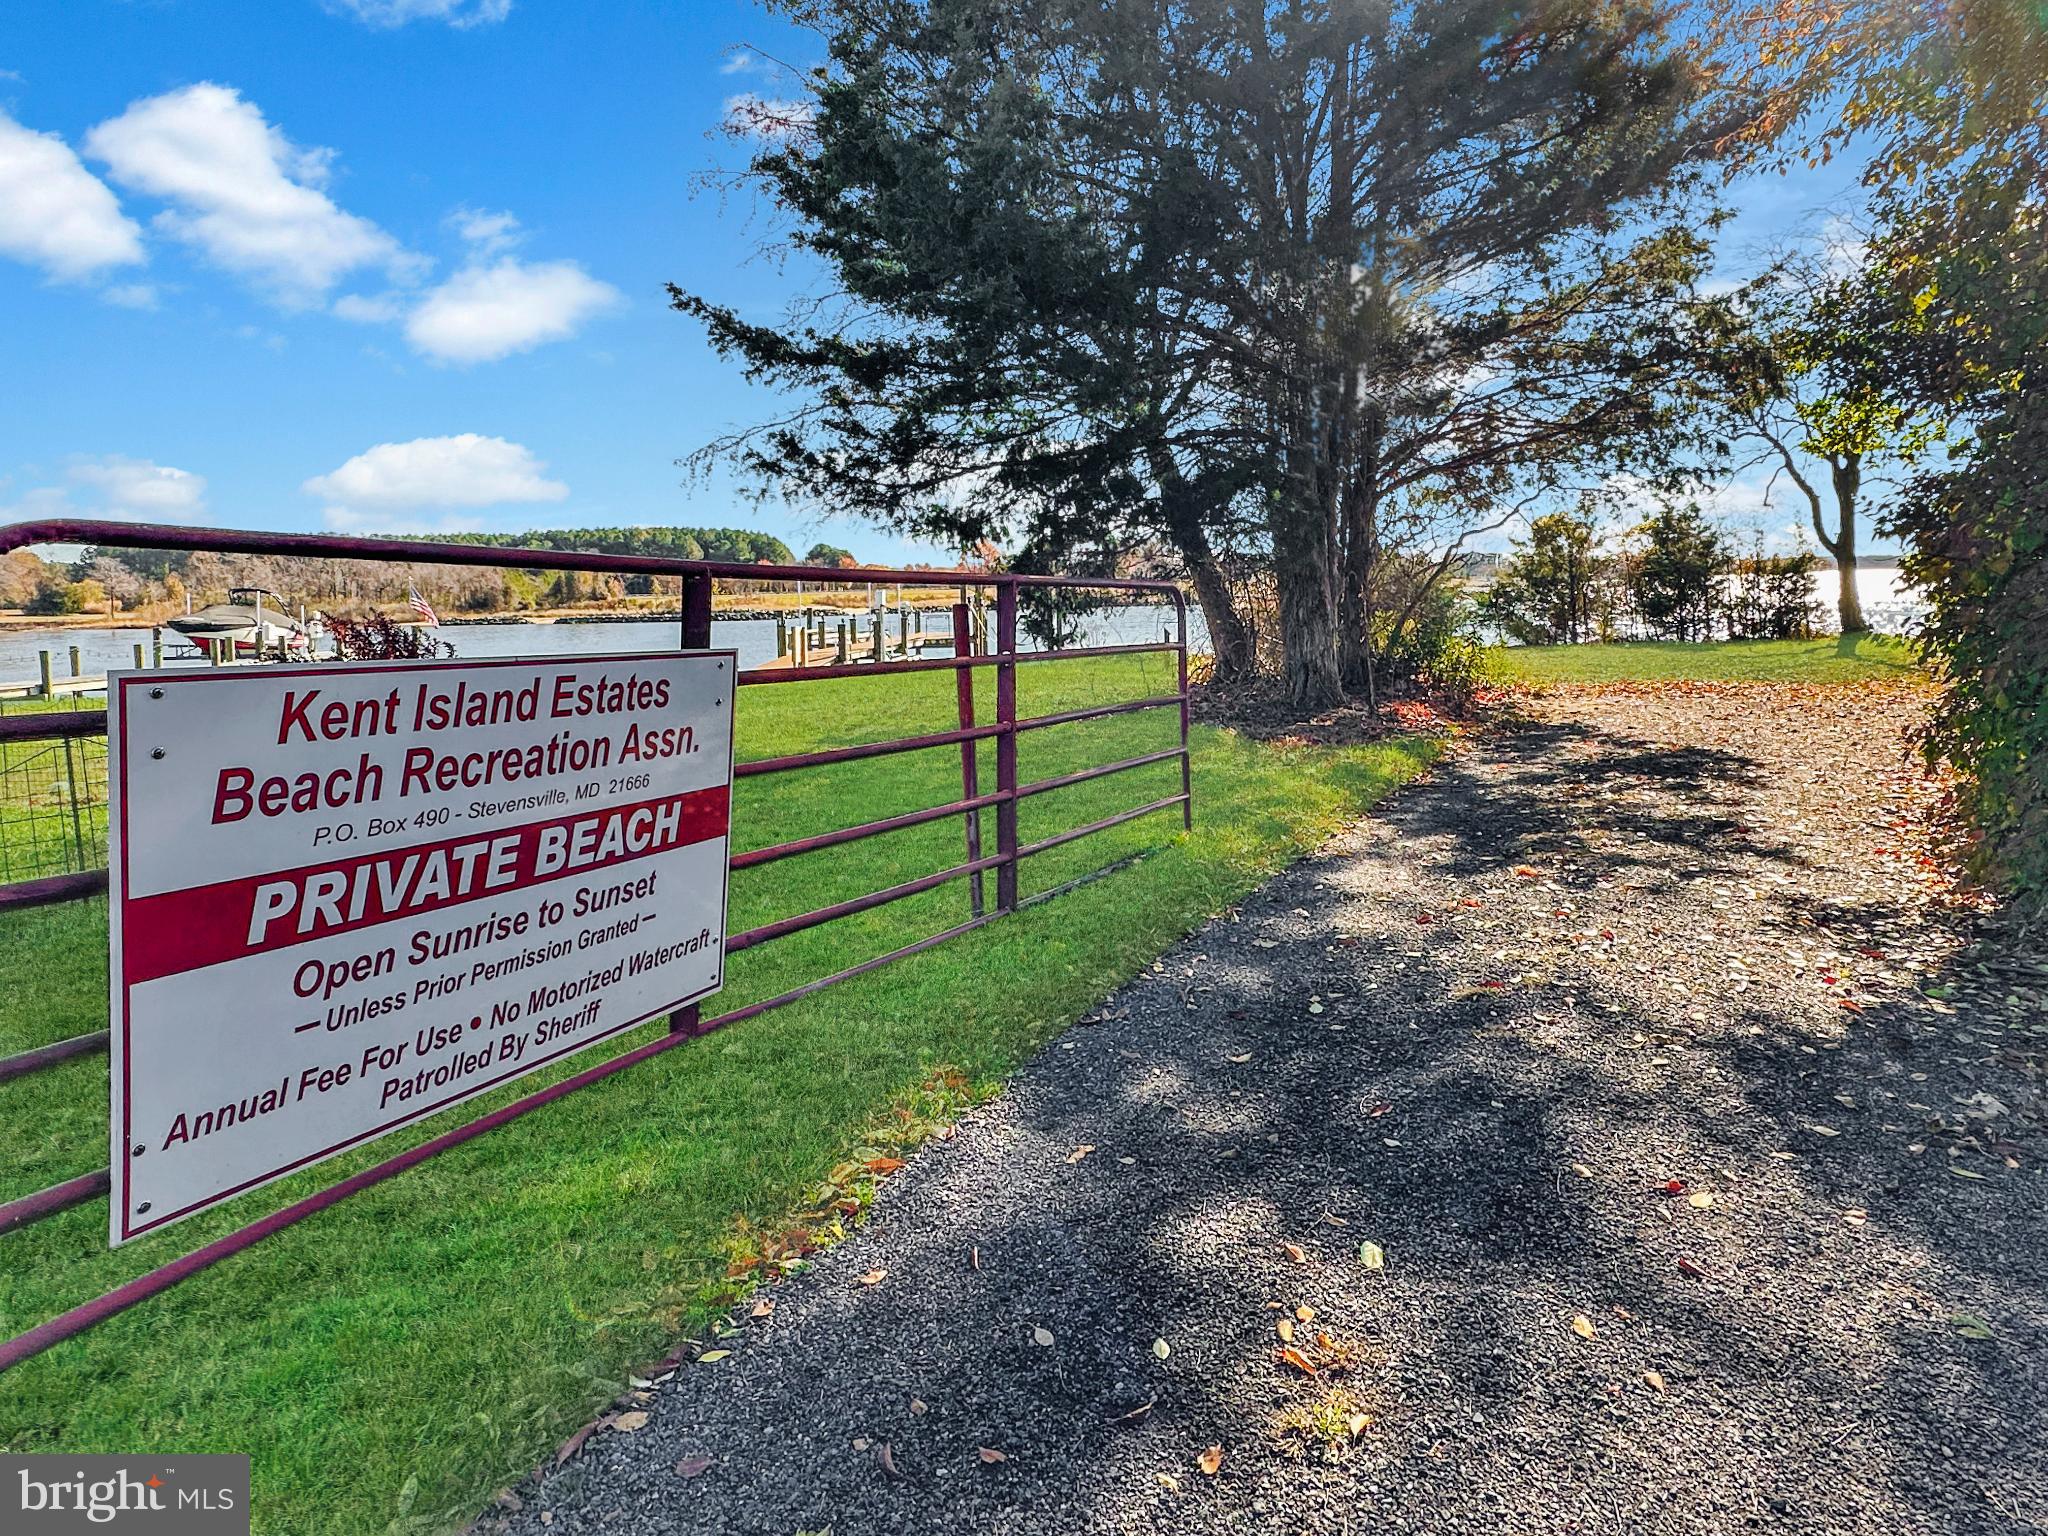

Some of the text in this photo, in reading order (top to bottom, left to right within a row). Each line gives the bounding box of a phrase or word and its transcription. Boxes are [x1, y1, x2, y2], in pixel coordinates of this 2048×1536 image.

[278, 673, 670, 744] Kent Island Estates
[211, 723, 700, 824] Beach Recreation Assn.
[313, 824, 358, 846] P.O.
[367, 817, 407, 839] Box
[414, 808, 449, 828] 490
[468, 788, 569, 819] Stevensville,
[574, 782, 600, 799] MD
[609, 774, 650, 793] 21666
[247, 802, 682, 946] PRIVATE BEACH
[293, 871, 657, 1001] Open Sunrise to Sunset
[413, 974, 466, 1006] Prior
[470, 938, 572, 986] Permission
[162, 928, 709, 1151] Annual Fee For Use No Motorized Watercraft
[380, 1000, 603, 1109] Patrolled By Sheriff
